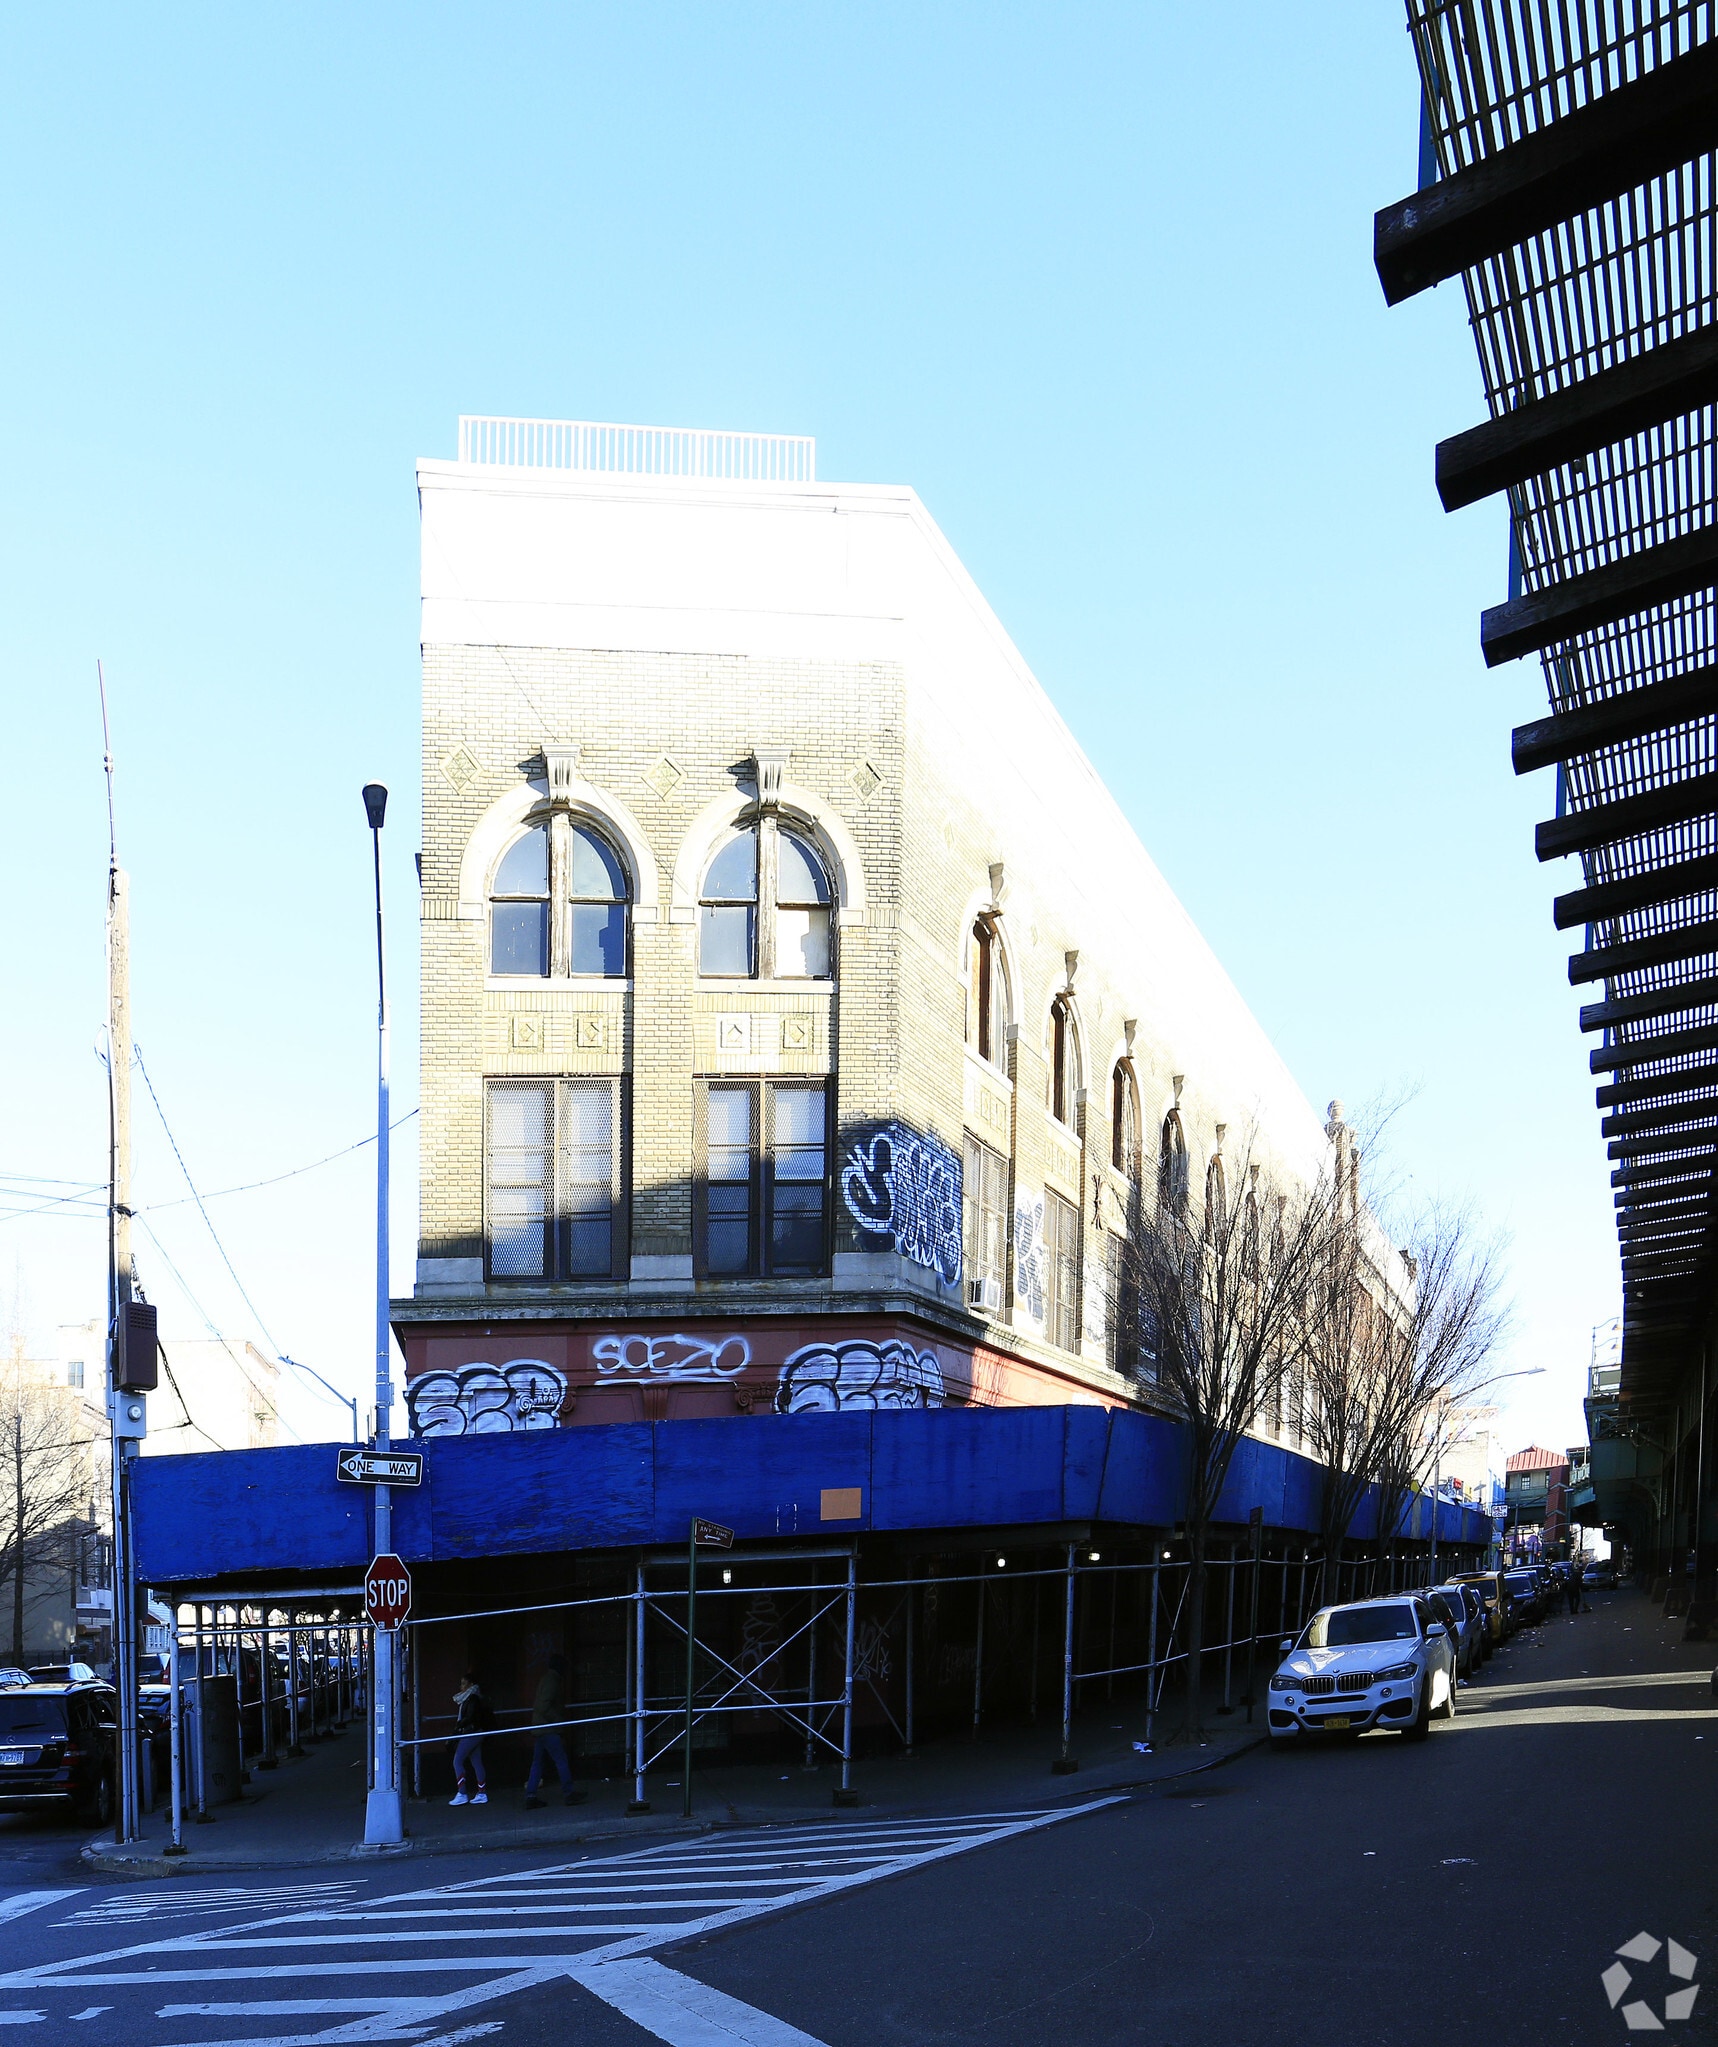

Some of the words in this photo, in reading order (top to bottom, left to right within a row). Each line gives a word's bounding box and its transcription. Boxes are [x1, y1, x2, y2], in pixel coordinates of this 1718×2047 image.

[347, 1459, 375, 1473] ONE
[389, 1462, 414, 1475] WAY
[715, 1531, 728, 1539] TIME
[368, 1578, 408, 1608] STOP
